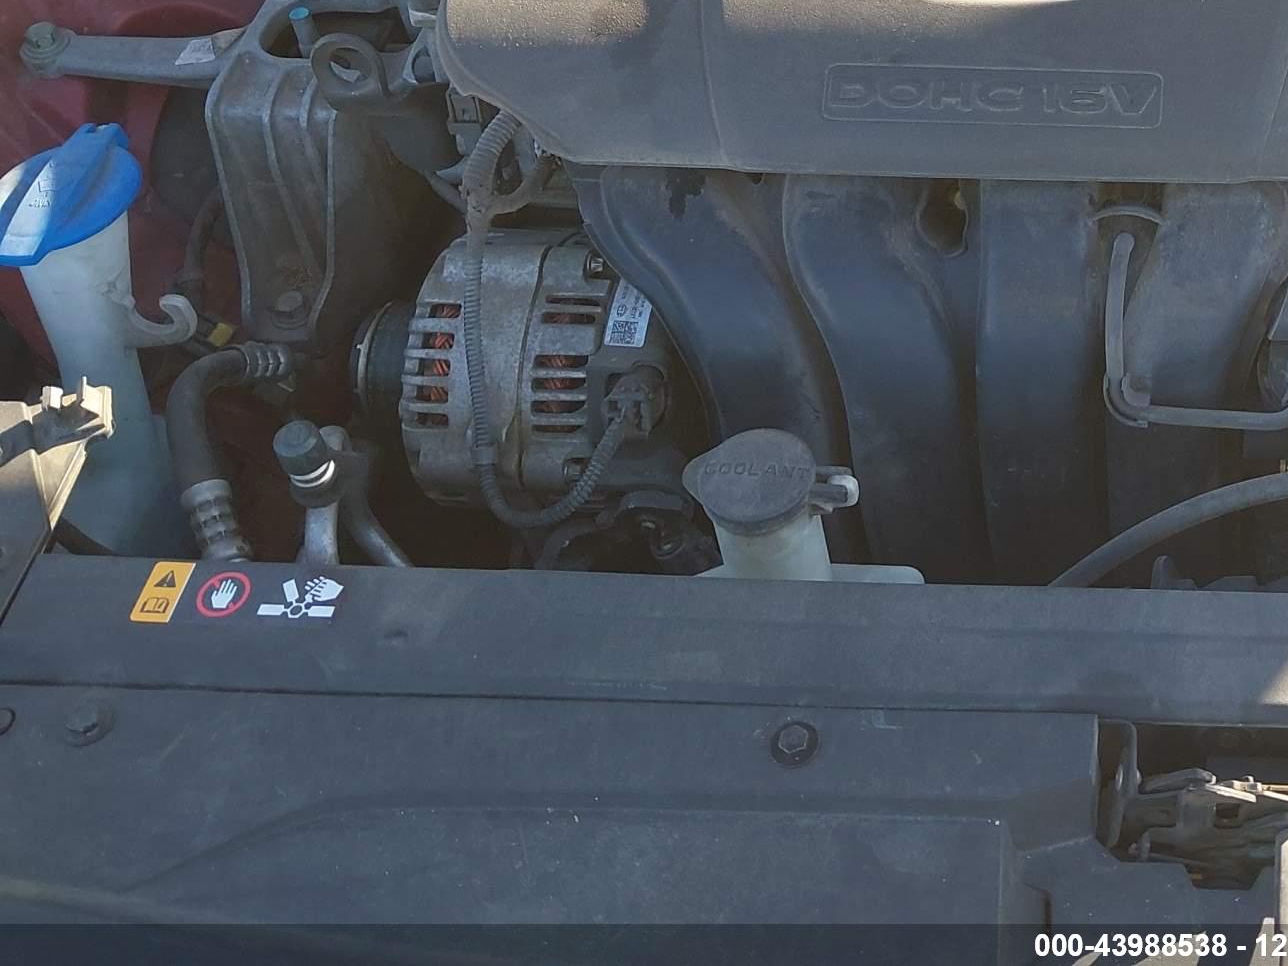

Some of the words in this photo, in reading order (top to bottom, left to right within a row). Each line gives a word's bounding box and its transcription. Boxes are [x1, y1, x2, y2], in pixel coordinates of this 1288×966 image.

[829, 82, 1025, 113] DOHC
[1041, 82, 1158, 116] 16V
[704, 462, 810, 478] COOLANT
